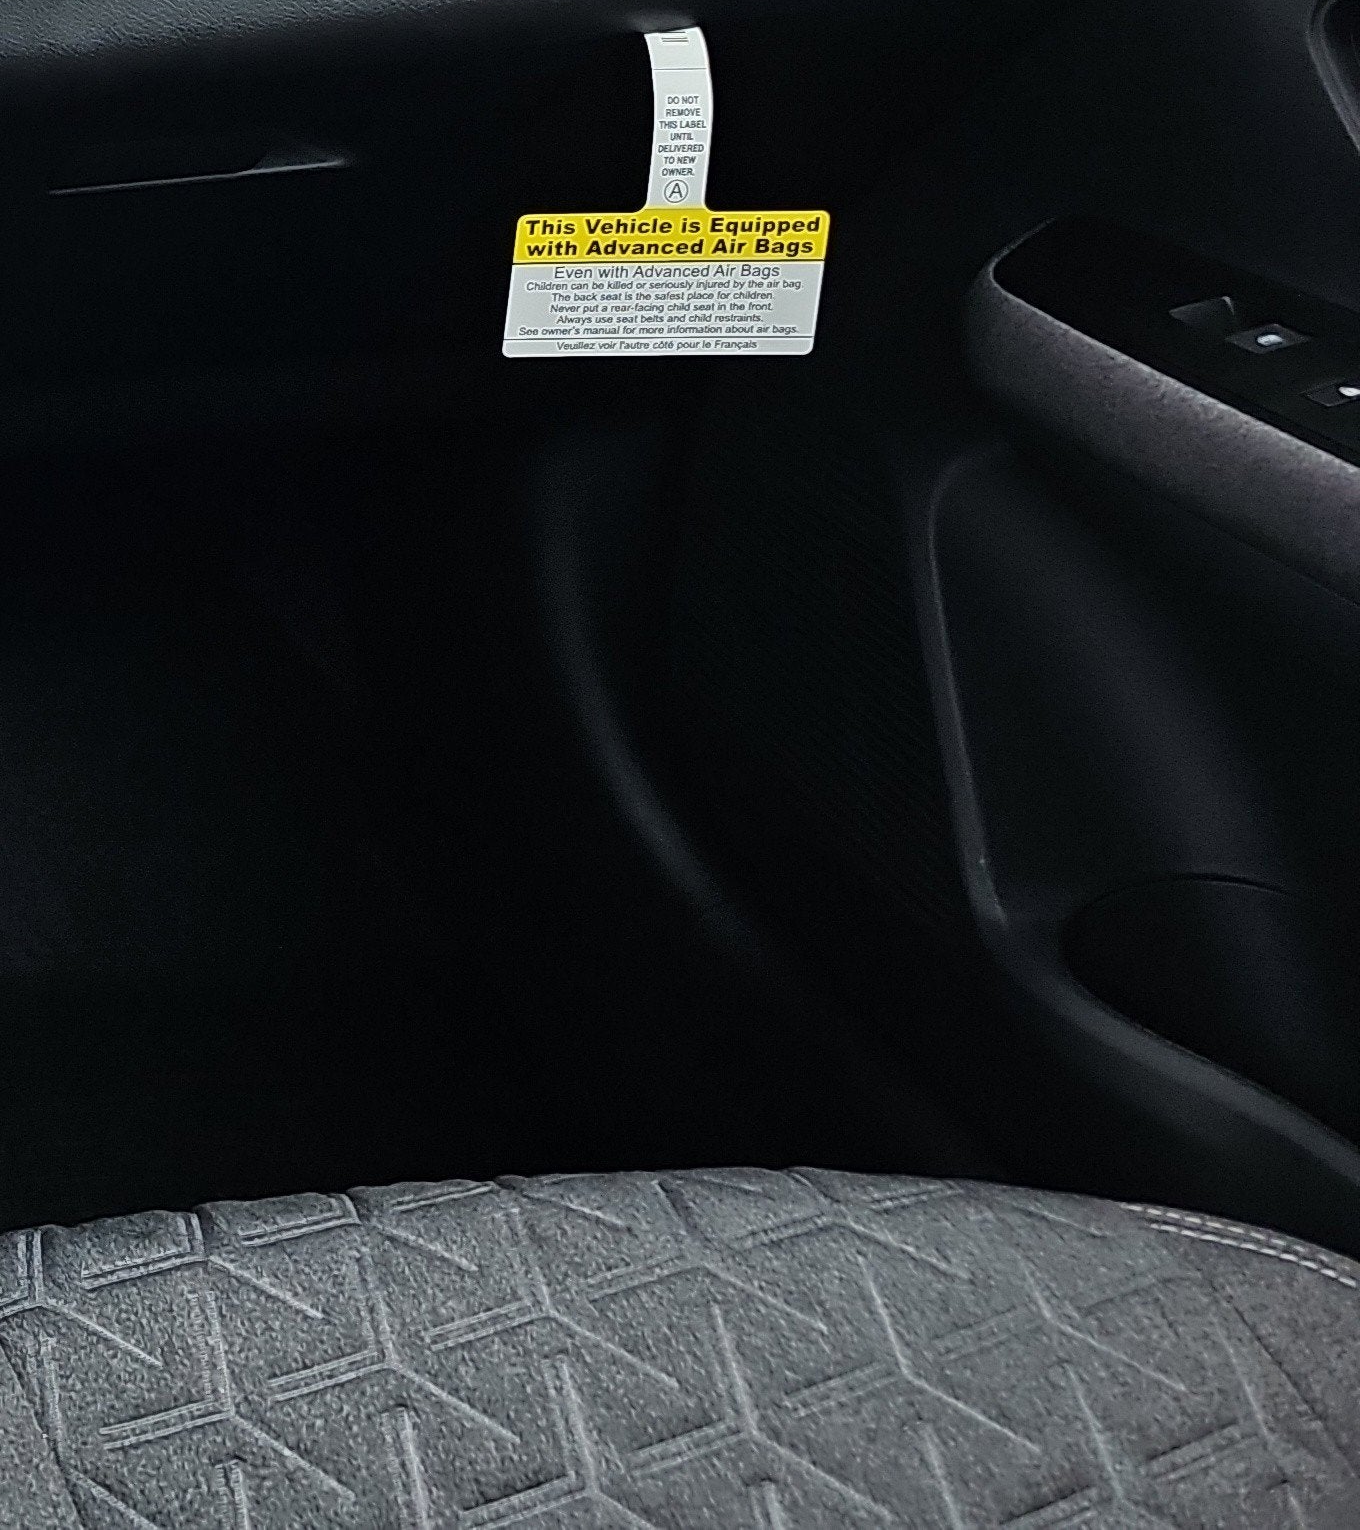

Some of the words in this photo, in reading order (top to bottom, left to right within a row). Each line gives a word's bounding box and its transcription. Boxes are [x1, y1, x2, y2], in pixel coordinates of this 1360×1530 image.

[667, 96, 679, 104] DO
[681, 96, 699, 104] NOT
[666, 108, 701, 117] REMOVE
[659, 121, 677, 129] THIS
[679, 120, 706, 128] LABEL
[670, 133, 693, 141] UNTIL
[658, 144, 704, 153] DELIVERED
[664, 156, 675, 164] TO
[677, 156, 696, 164] NEW
[661, 168, 695, 176] OWNER.
[668, 182, 683, 198] A
[526, 219, 576, 235] This
[585, 218, 672, 234] Vehicle
[681, 218, 701, 233] is
[710, 217, 821, 236] Equipped
[527, 241, 577, 256] with
[585, 239, 704, 255] Advanced
[711, 239, 747, 254] Air
[755, 239, 813, 257] Bags
[554, 266, 592, 278] Even
[598, 266, 629, 278] with
[633, 265, 710, 278] Advanced
[713, 265, 735, 277] Air
[741, 264, 780, 279] Bags
[526, 281, 568, 291] Children
[592, 281, 604, 289] be
[607, 281, 633, 289] killed
[649, 280, 693, 290] seriously
[696, 280, 730, 290] injured
[733, 280, 746, 290] by
[748, 279, 764, 288] the
[767, 280, 780, 288] air
[783, 280, 803, 290] bag.
[552, 293, 570, 301] The
[574, 292, 597, 301] back
[600, 293, 622, 301] seat
[625, 293, 632, 301] is
[635, 292, 651, 301] the
[654, 292, 684, 301] safest
[687, 291, 714, 301] place
[717, 291, 730, 300] for
[733, 291, 774, 300] children.
[550, 304, 581, 313] Never
[582, 304, 599, 314] put
[611, 303, 665, 313] rear-facing
[667, 303, 690, 311] child
[693, 303, 715, 311] seat
[717, 303, 726, 311] in
[730, 302, 745, 310] the
[748, 302, 774, 311] front.
[556, 315, 592, 325] Always
[595, 316, 613, 324] use
[616, 315, 638, 324] seat
[641, 314, 664, 323] belts
[667, 314, 686, 323] and
[689, 314, 712, 323] child
[715, 314, 764, 322] restraints.
[519, 327, 539, 336] See
[542, 326, 580, 335] owner's
[583, 326, 620, 335] manual
[623, 326, 636, 335] for
[667, 325, 722, 334] information
[725, 325, 754, 334] about
[756, 325, 770, 333] air
[773, 325, 799, 335] bags.
[557, 341, 596, 350] Veuillez
[598, 341, 617, 349] voir
[677, 341, 699, 351] pour
[702, 340, 711, 348] le
[714, 340, 758, 350] Français
